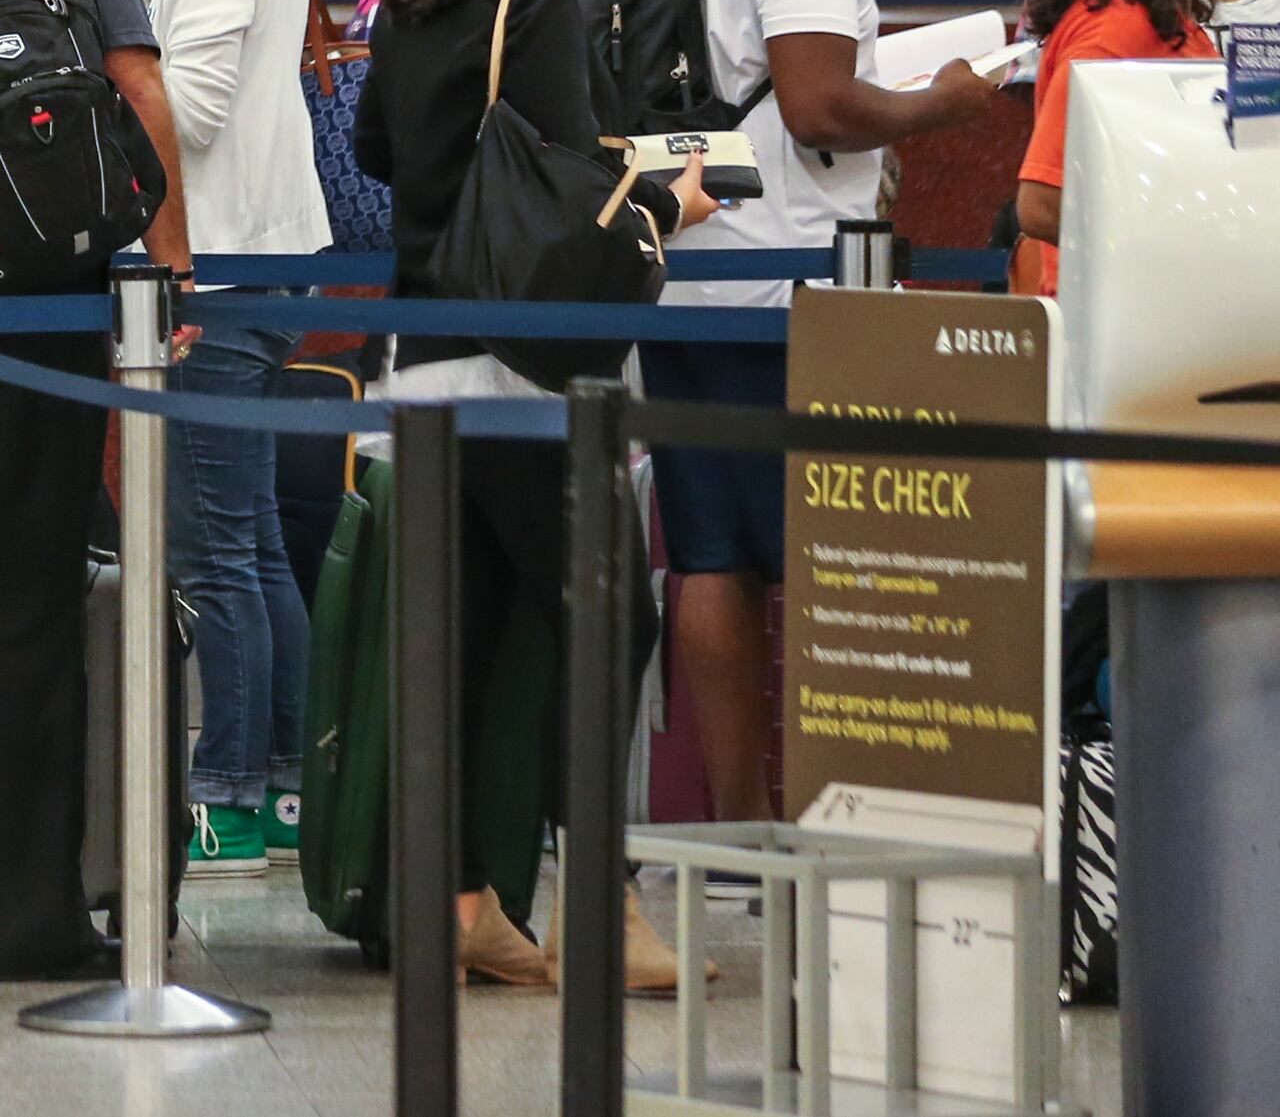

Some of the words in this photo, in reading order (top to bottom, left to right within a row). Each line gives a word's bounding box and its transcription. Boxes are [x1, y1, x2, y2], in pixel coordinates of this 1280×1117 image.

[955, 328, 1017, 356] DELTA
[804, 461, 866, 511] SIZE
[873, 466, 972, 520] CHECK
[812, 691, 838, 713] your
[888, 695, 931, 721] doesn't
[932, 698, 948, 723] fit
[948, 700, 973, 726] into
[973, 704, 997, 729] this
[799, 715, 841, 737] service
[841, 718, 888, 745] charges
[888, 724, 914, 750] may
[951, 916, 981, 946] 22"
